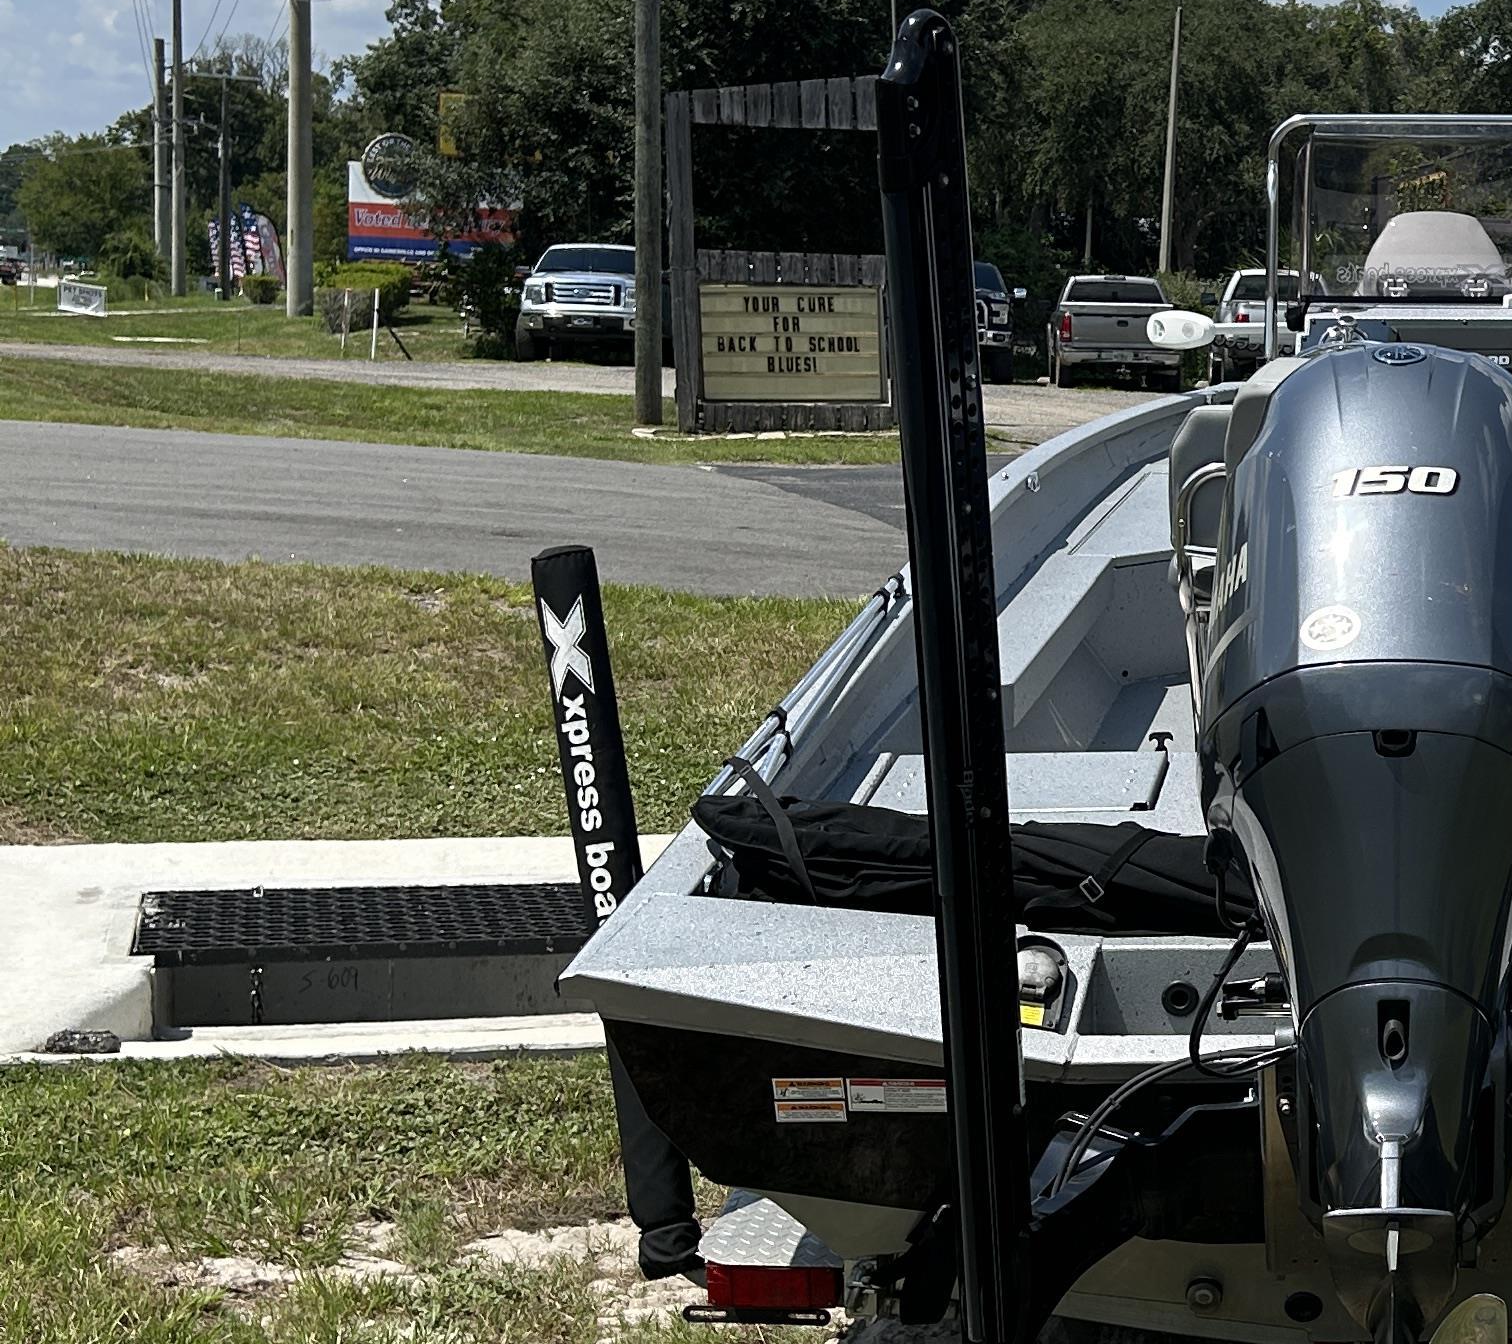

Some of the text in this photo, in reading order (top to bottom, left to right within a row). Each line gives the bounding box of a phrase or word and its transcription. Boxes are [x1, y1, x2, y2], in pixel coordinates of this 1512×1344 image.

[354, 208, 402, 229] Voted
[743, 296, 835, 312] YOUR CURE
[773, 316, 800, 333] FOR
[717, 336, 860, 352] BACK TO SCHOOL
[767, 356, 818, 373] BLUES!
[1330, 465, 1459, 497] 150
[561, 692, 603, 832] xpress
[584, 840, 617, 927] boa
